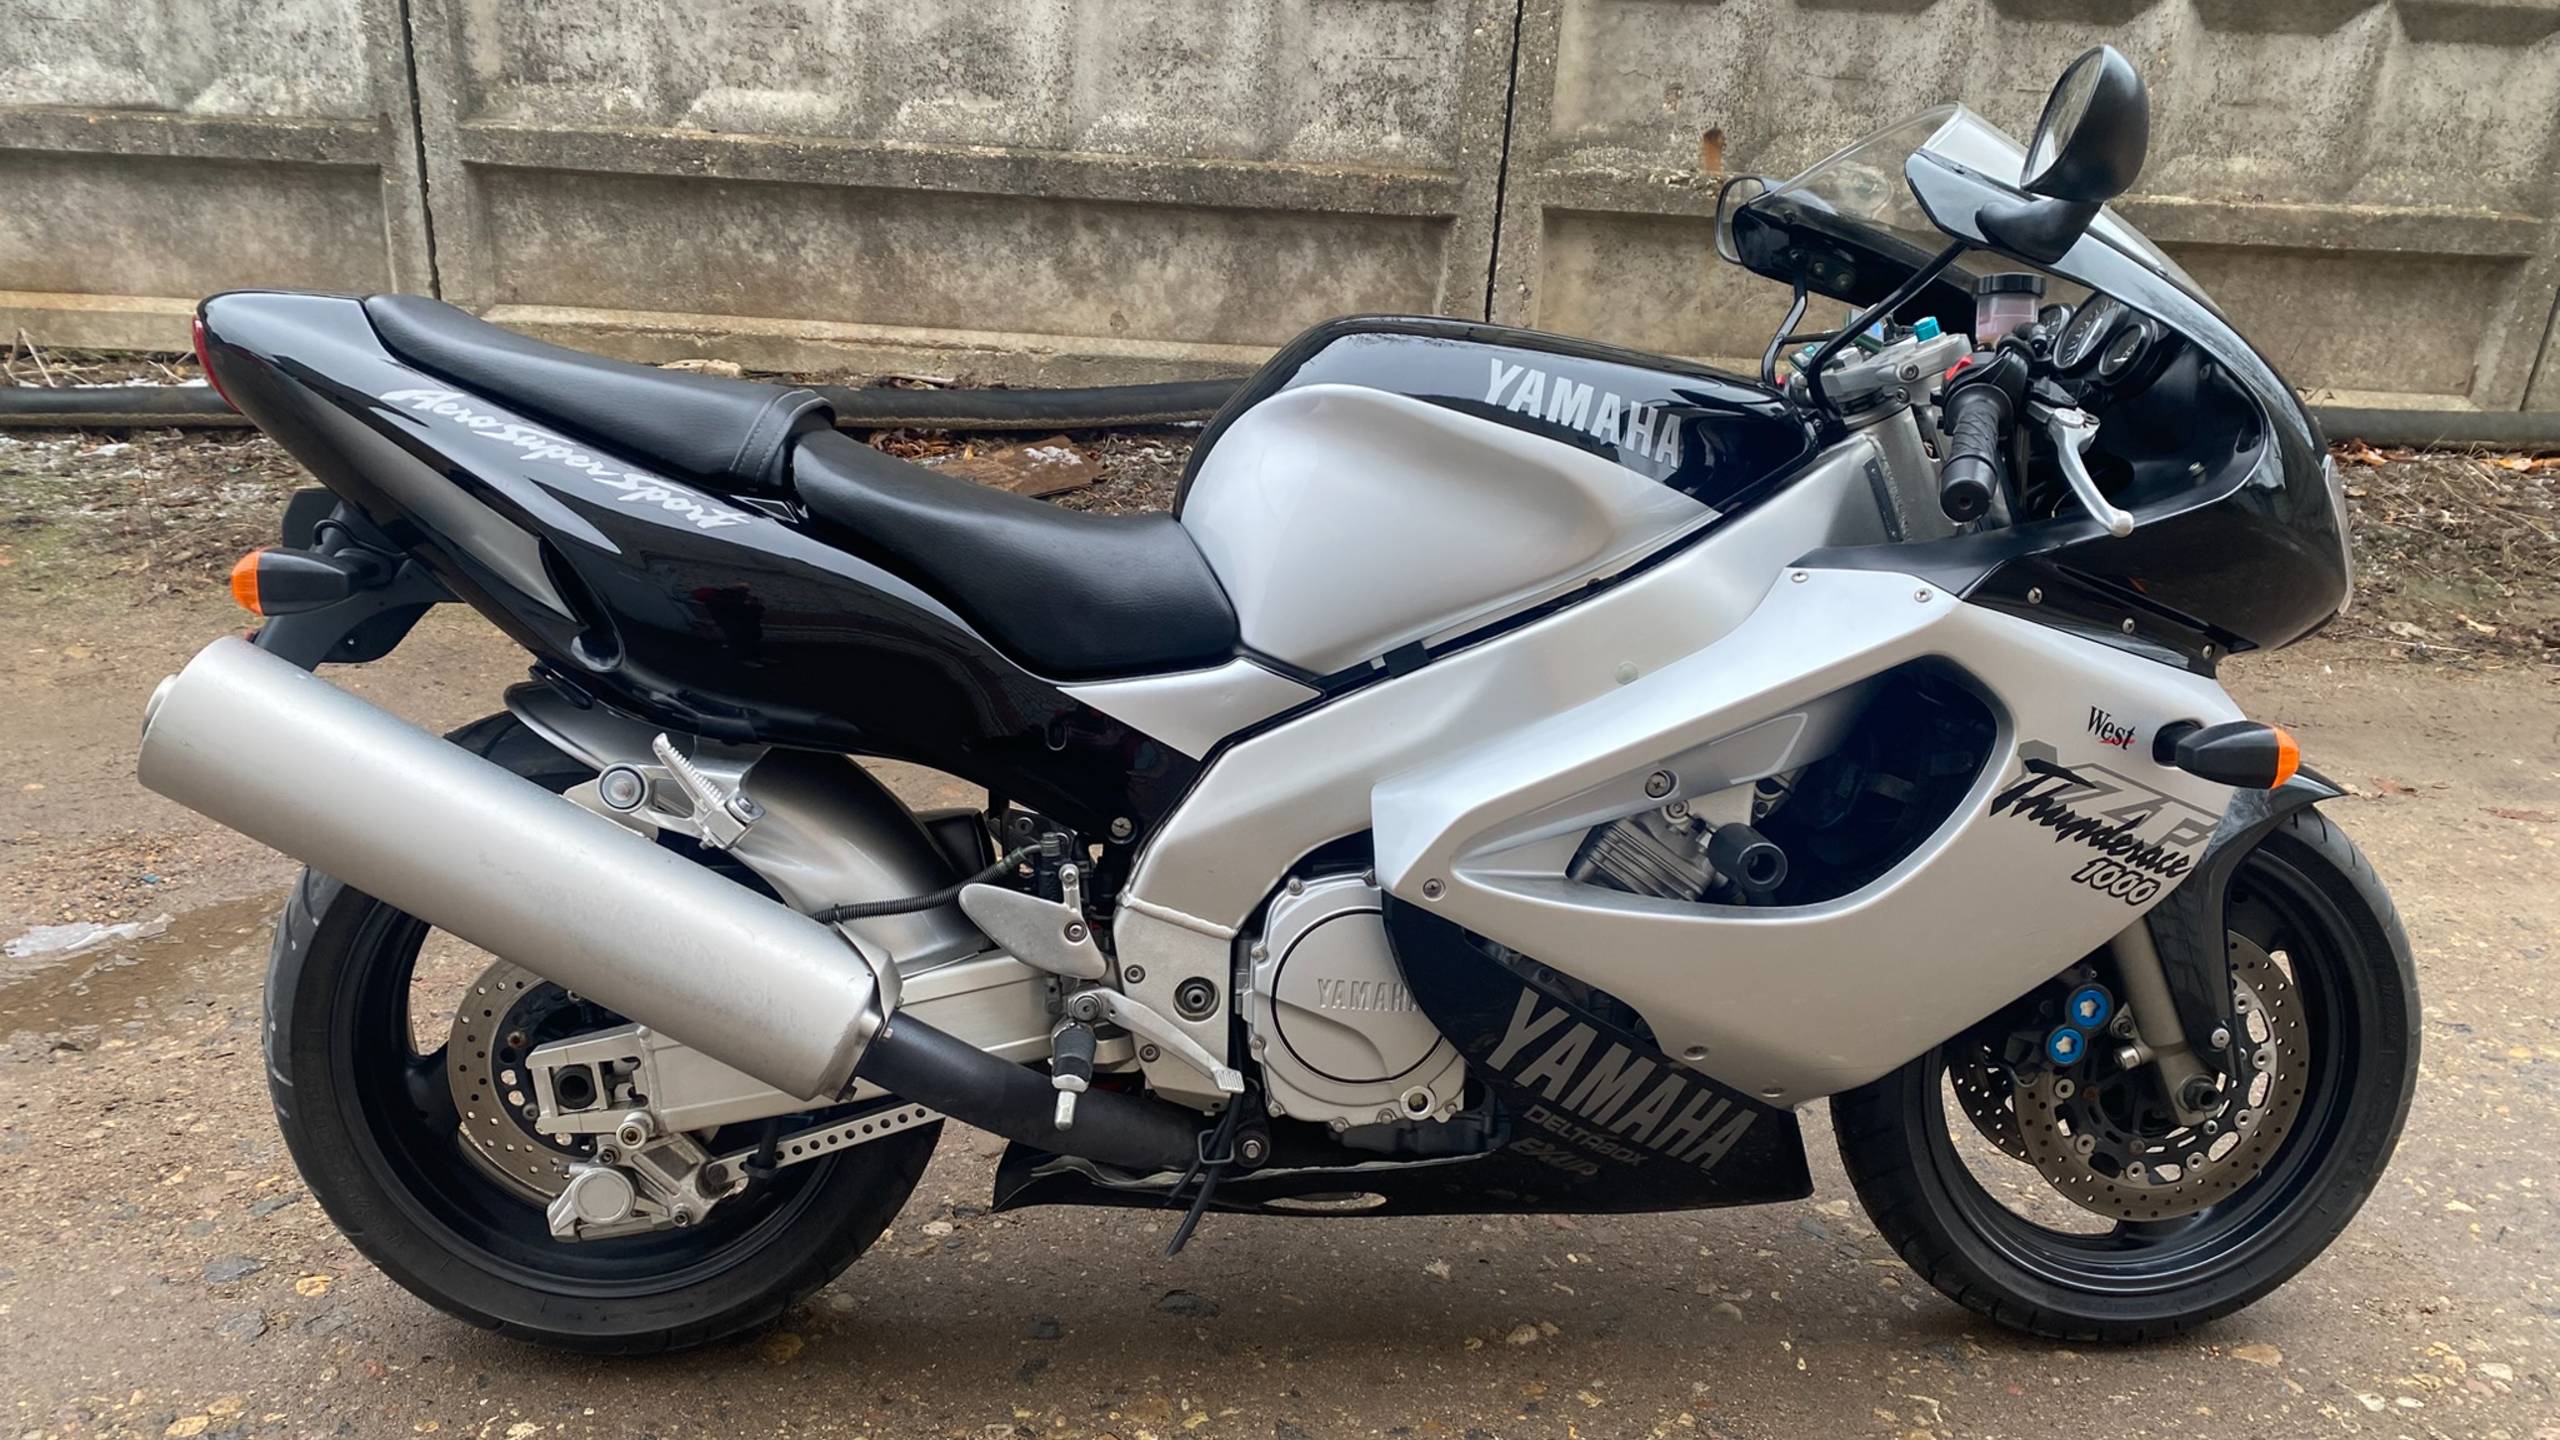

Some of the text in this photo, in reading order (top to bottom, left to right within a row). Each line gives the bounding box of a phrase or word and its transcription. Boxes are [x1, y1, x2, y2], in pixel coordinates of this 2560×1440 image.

[1484, 358, 1682, 468] YAMAHA
[2088, 705, 2136, 750] West
[1989, 758, 2192, 878] Thunderace
[2071, 856, 2161, 906] 1000
[1486, 986, 1758, 1169] YAMAHA
[1523, 1104, 1649, 1167] DELTABOX
